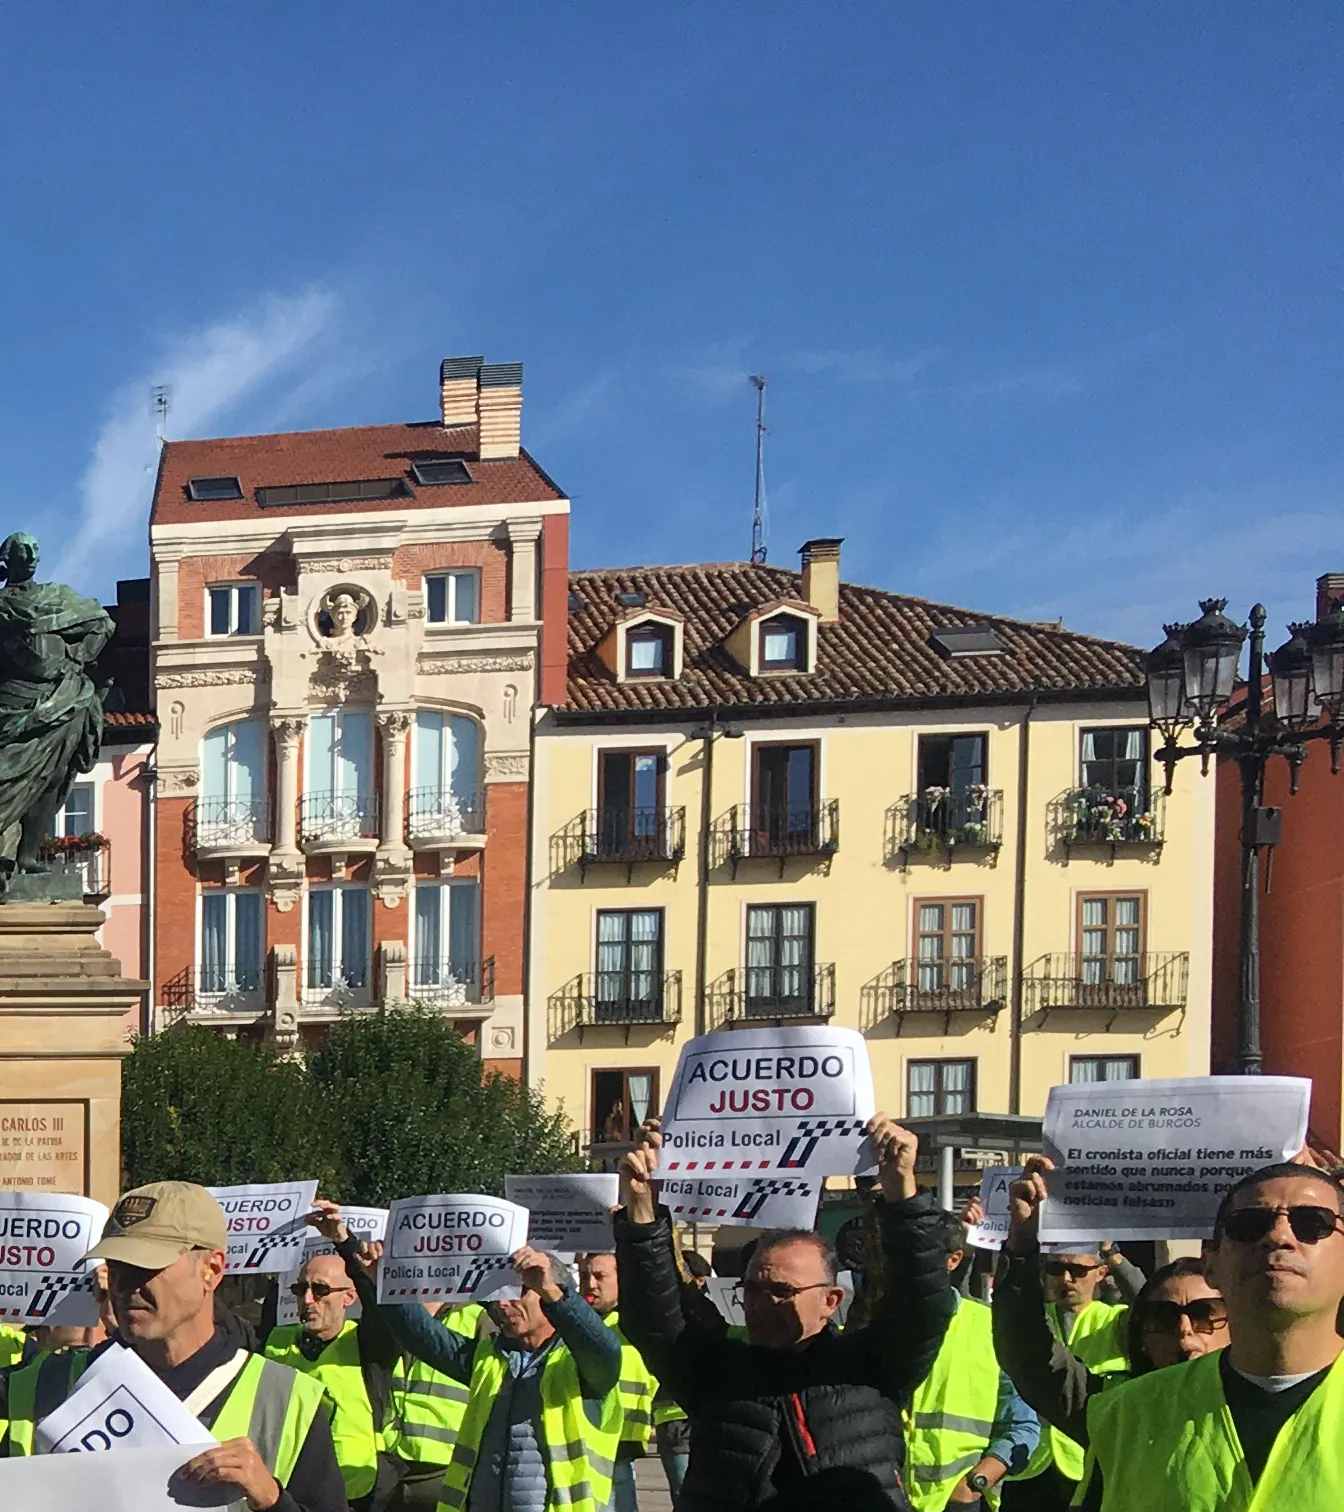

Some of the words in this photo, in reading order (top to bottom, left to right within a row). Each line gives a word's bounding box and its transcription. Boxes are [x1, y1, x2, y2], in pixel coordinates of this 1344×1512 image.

[688, 1055, 844, 1084] ACUERDO
[709, 1087, 815, 1113] JUSTO
[1073, 1108, 1117, 1118] DANIEL
[1121, 1107, 1138, 1117] DE
[1141, 1107, 1156, 1117] LA
[1159, 1106, 1193, 1117] ROSA
[1, 1117, 47, 1132] CARLOS
[53, 1117, 64, 1132] III
[1071, 1119, 1124, 1129] ALCALDE
[1128, 1119, 1145, 1129] DE
[1148, 1117, 1202, 1129] BURGOS
[13, 1137, 22, 1146] DE
[25, 1137, 34, 1146] LA
[37, 1137, 62, 1146] PATRIA
[662, 1130, 724, 1149] Policía
[731, 1129, 781, 1147] Local
[25, 1152, 34, 1161] DE
[38, 1152, 52, 1161] LAS
[55, 1151, 78, 1161] ARTES
[1067, 1148, 1082, 1160] El
[1085, 1148, 1143, 1161] cronista
[1147, 1147, 1192, 1161] oficial
[1196, 1147, 1235, 1160] tiene
[1239, 1145, 1273, 1160] más
[1064, 1163, 1117, 1176] sentido
[1121, 1167, 1147, 1178] que
[1150, 1166, 1194, 1176] nunca
[2, 1176, 34, 1186] ANTONIO
[661, 1178, 693, 1195] licía
[698, 1181, 739, 1199] Local
[1063, 1180, 1124, 1191] estamos
[1128, 1180, 1208, 1192] abrumados
[1214, 1182, 1233, 1194] po
[1063, 1195, 1118, 1206] noticias
[399, 1211, 505, 1231] ACUERDO
[413, 1233, 483, 1253] JUSTO
[383, 1265, 424, 1280] Policía
[427, 1264, 460, 1278] Local
